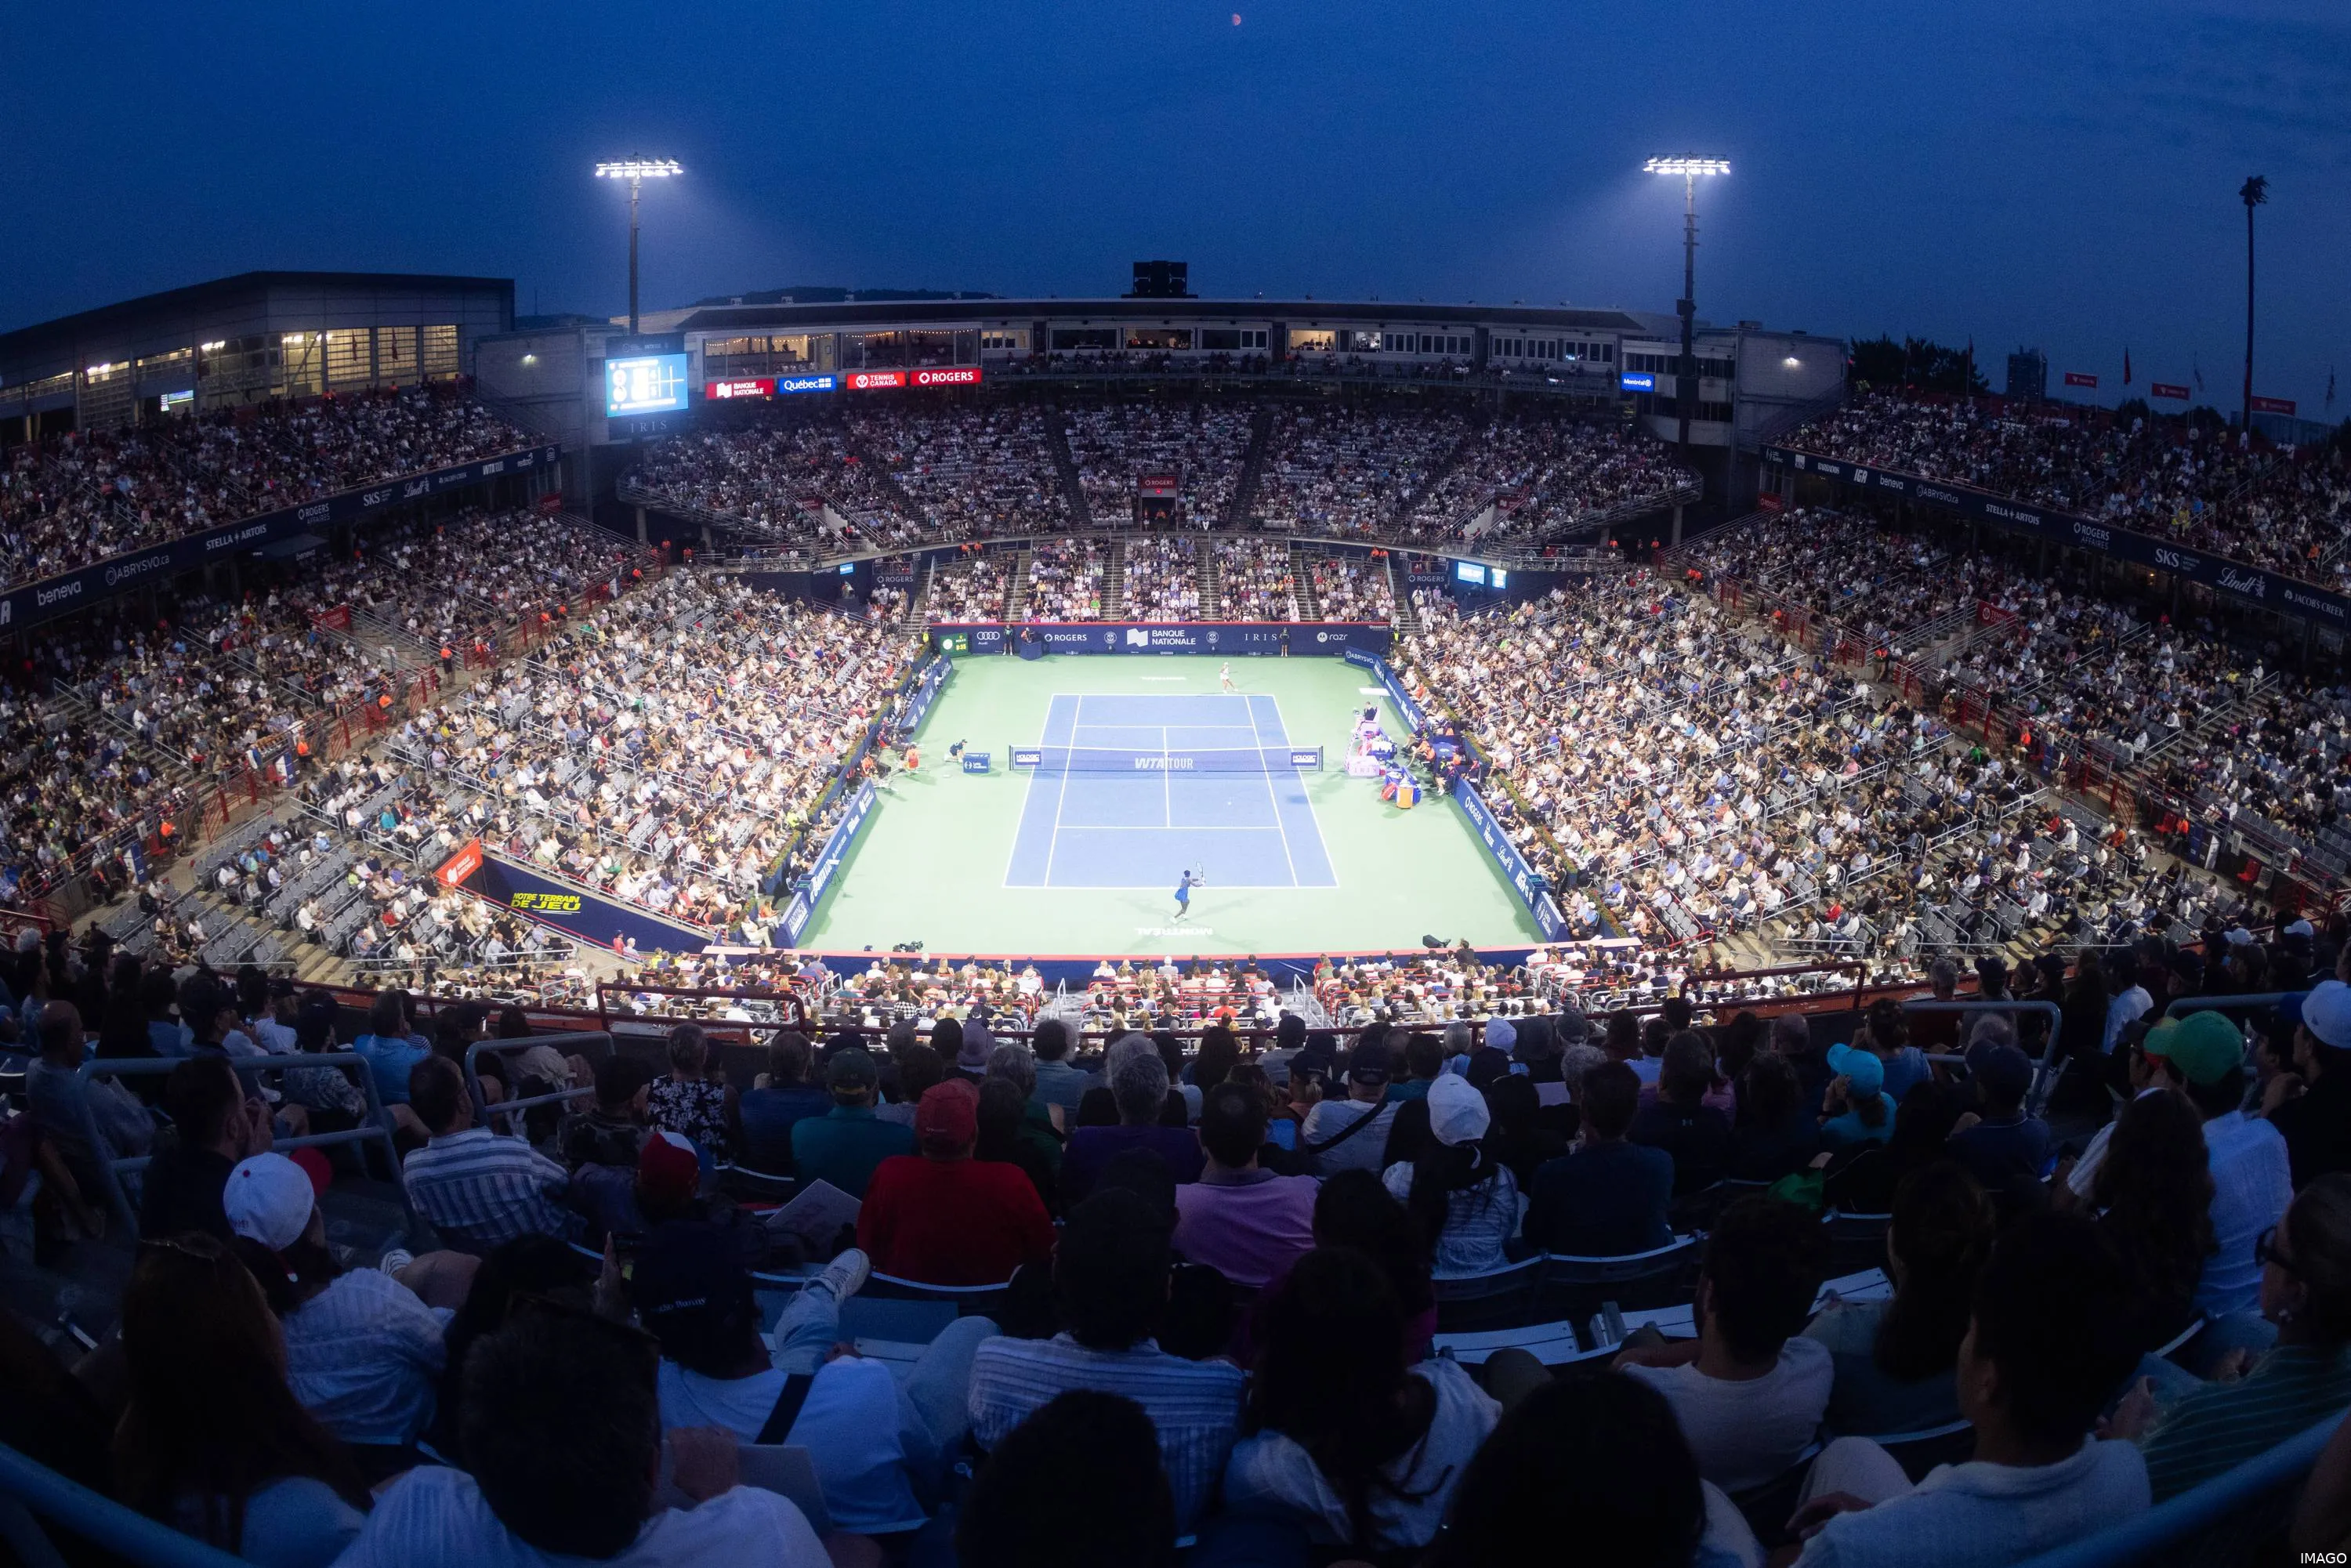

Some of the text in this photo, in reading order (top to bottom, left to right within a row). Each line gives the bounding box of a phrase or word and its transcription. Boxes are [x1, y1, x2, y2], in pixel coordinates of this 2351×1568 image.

[932, 371, 973, 382] ROGERS
[784, 379, 819, 391] Québec
[630, 420, 667, 433] IRIS
[1853, 468, 1868, 483] IGA
[1879, 474, 1904, 490] beneva
[363, 491, 380, 507] SKS
[1922, 487, 1959, 504] ABRYSVO.ca
[305, 502, 329, 517] ROGERS
[1986, 504, 2041, 525] STELLA ARTOIS
[205, 523, 267, 551] STELLA ARTOIS
[2081, 525, 2110, 541] ROGERS
[2155, 548, 2179, 567] SKS
[117, 554, 170, 580] ABRYSVO.ca
[2216, 567, 2257, 593] Lindt
[37, 580, 82, 607] beneva
[2321, 602, 2346, 617] CREEK
[1135, 757, 1194, 770] WTA TOUR
[1469, 801, 1483, 826] ROGERS
[511, 900, 581, 911] DE JEU
[513, 893, 581, 903] NOTRE TERRAIN
